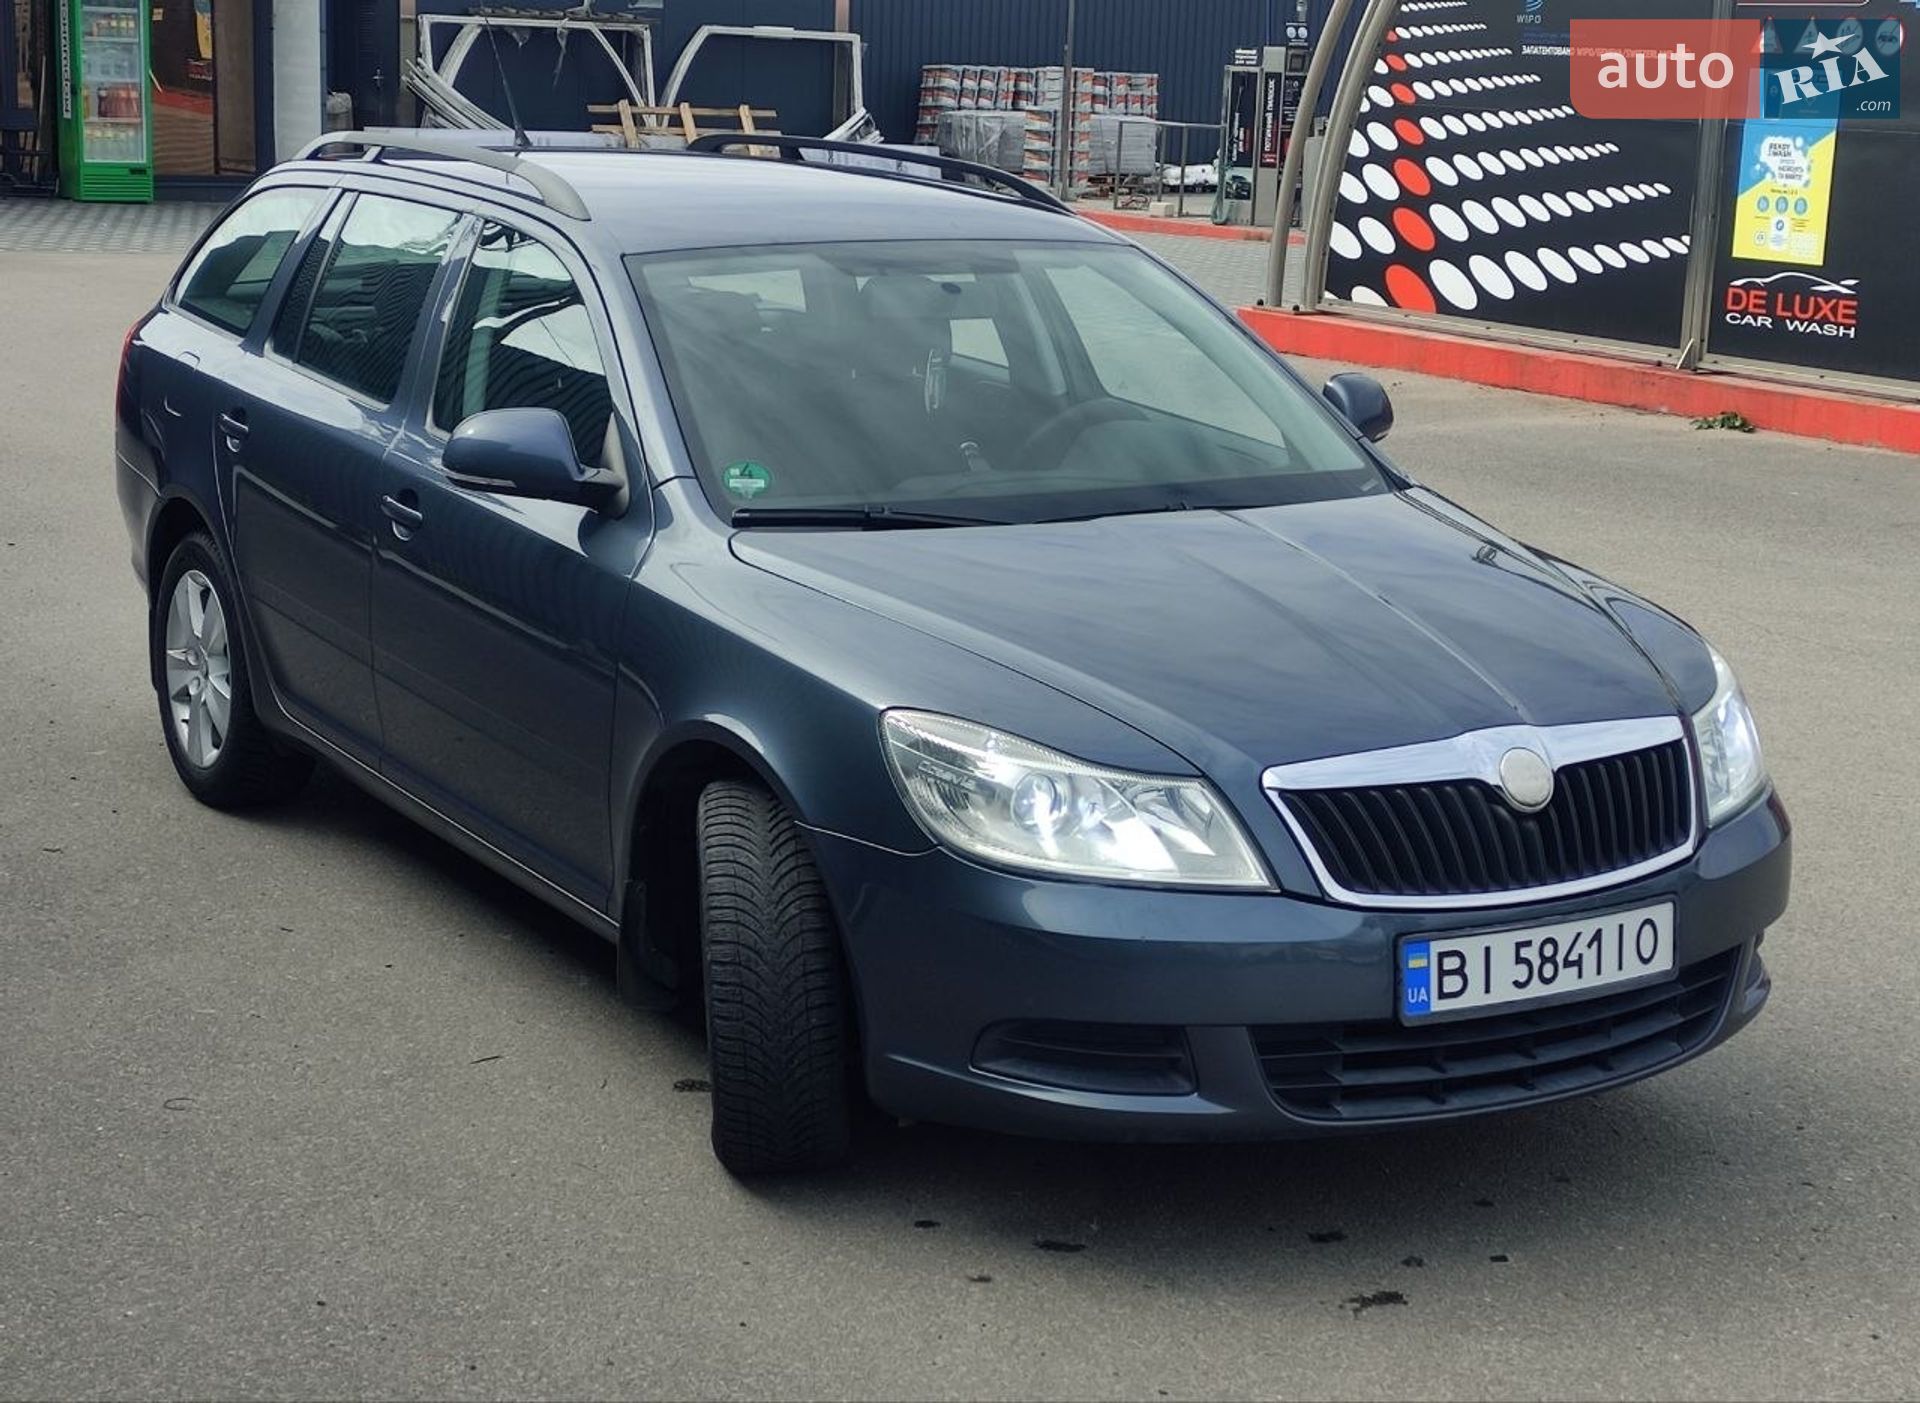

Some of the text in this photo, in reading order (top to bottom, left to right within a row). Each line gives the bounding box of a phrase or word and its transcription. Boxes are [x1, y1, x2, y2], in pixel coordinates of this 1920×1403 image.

[1516, 14, 1542, 24] WIPO
[1726, 287, 1858, 324] DE LUXE
[1725, 313, 1855, 338] CAR WASH
[1437, 918, 1658, 1000] BI 5841 IO
[1408, 986, 1428, 1004] UA
